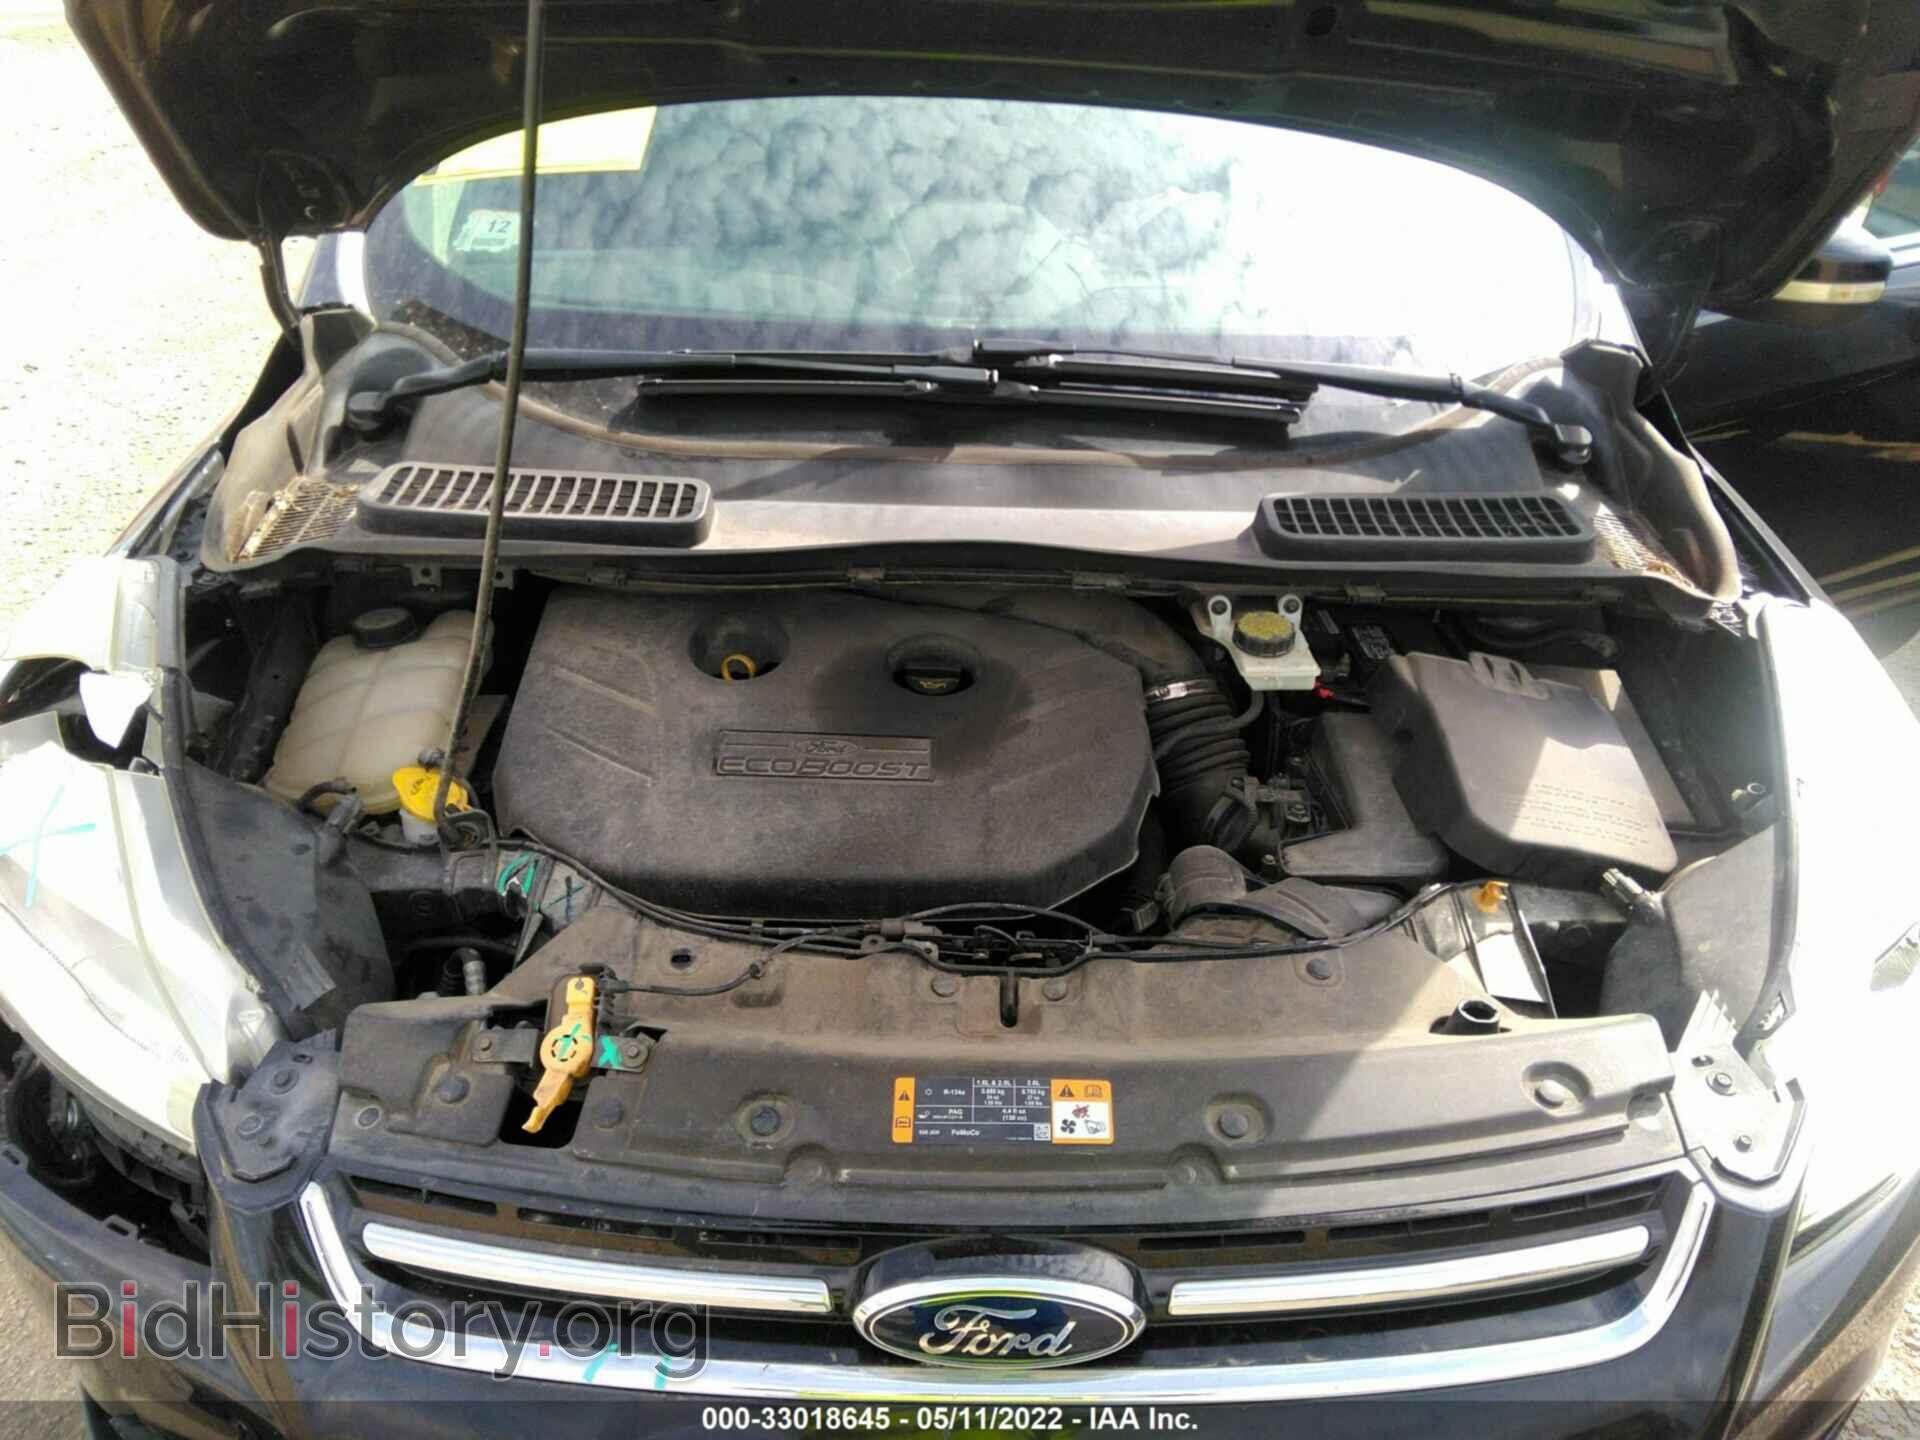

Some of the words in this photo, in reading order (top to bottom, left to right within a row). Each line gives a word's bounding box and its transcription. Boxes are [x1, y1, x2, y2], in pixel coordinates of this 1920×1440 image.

[487, 219, 511, 233] 12
[719, 756, 929, 778] ECOBOOST
[918, 1304, 1077, 1357] Ford
